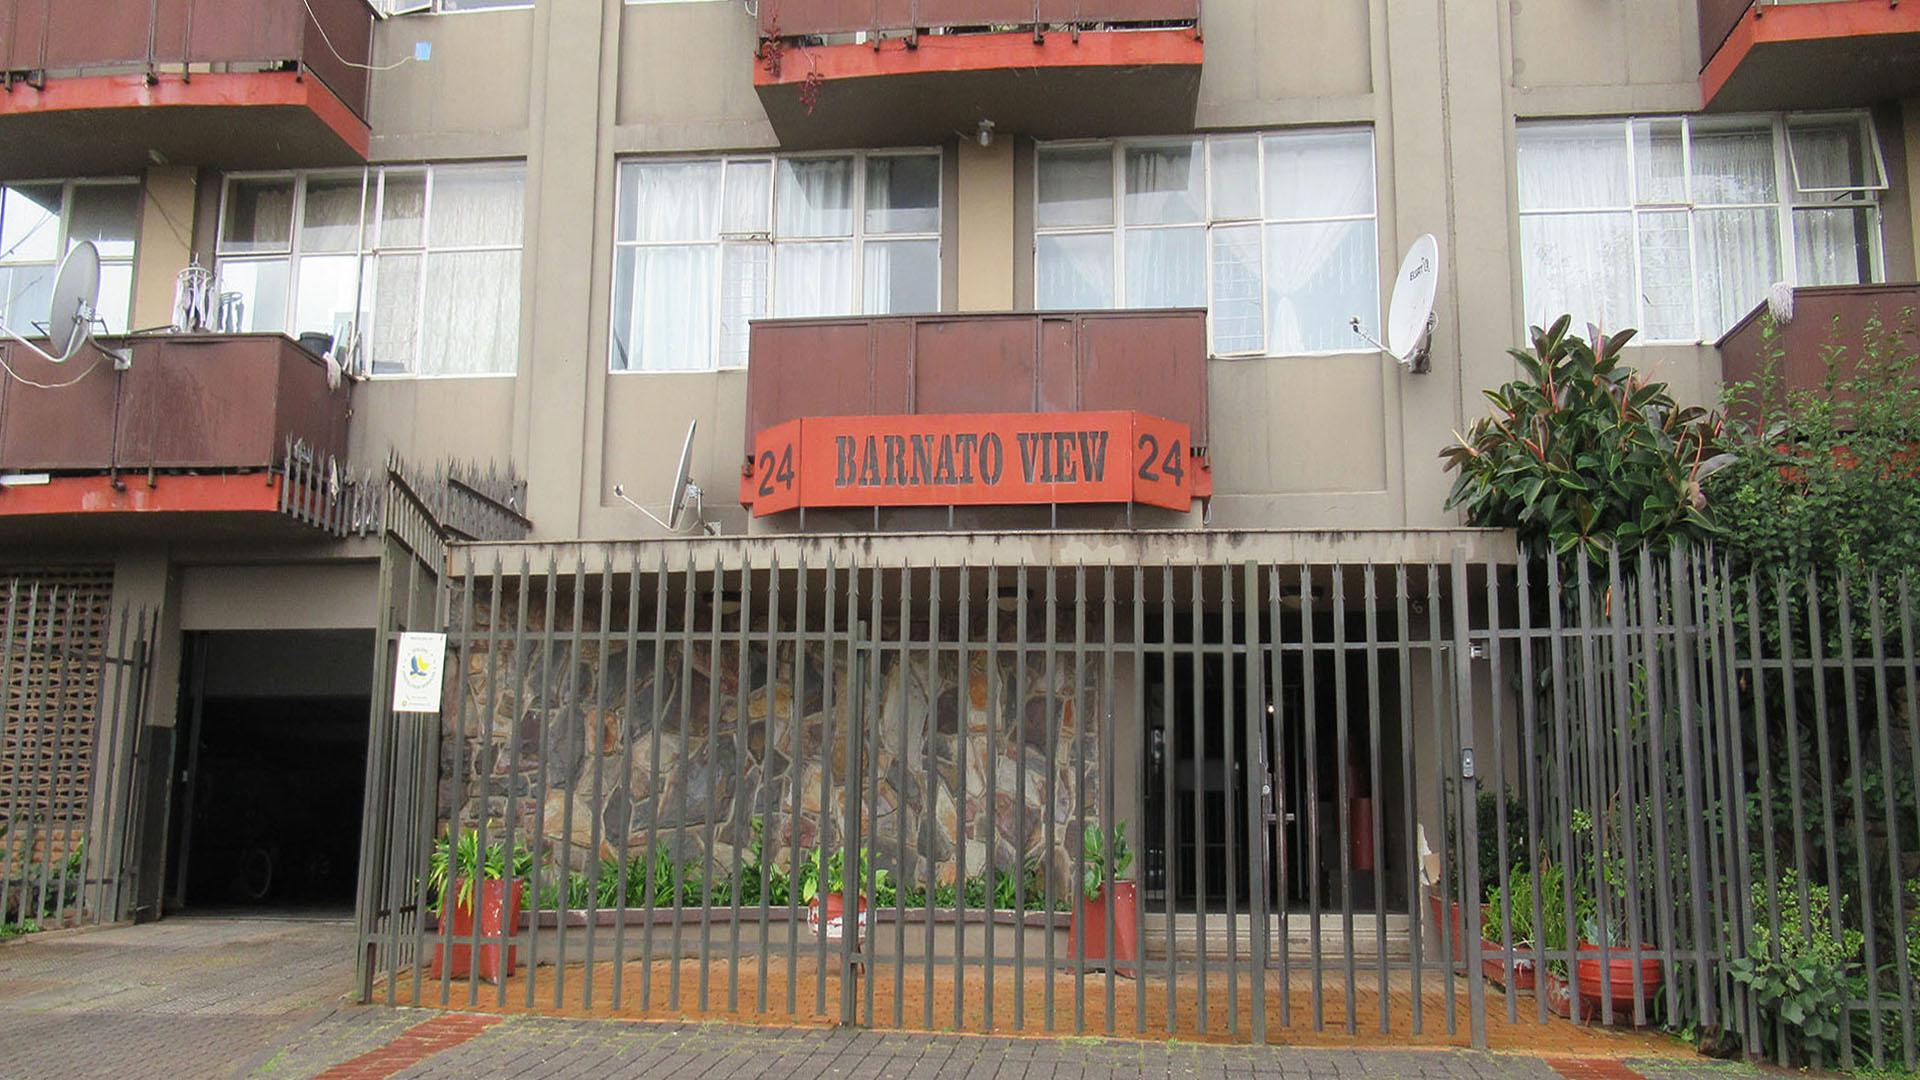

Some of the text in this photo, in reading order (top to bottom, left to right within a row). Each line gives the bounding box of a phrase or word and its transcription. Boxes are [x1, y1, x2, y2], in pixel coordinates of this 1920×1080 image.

[759, 444, 795, 496] 24
[834, 431, 1109, 488] BARNATO VIEW
[1138, 434, 1185, 487] 24
